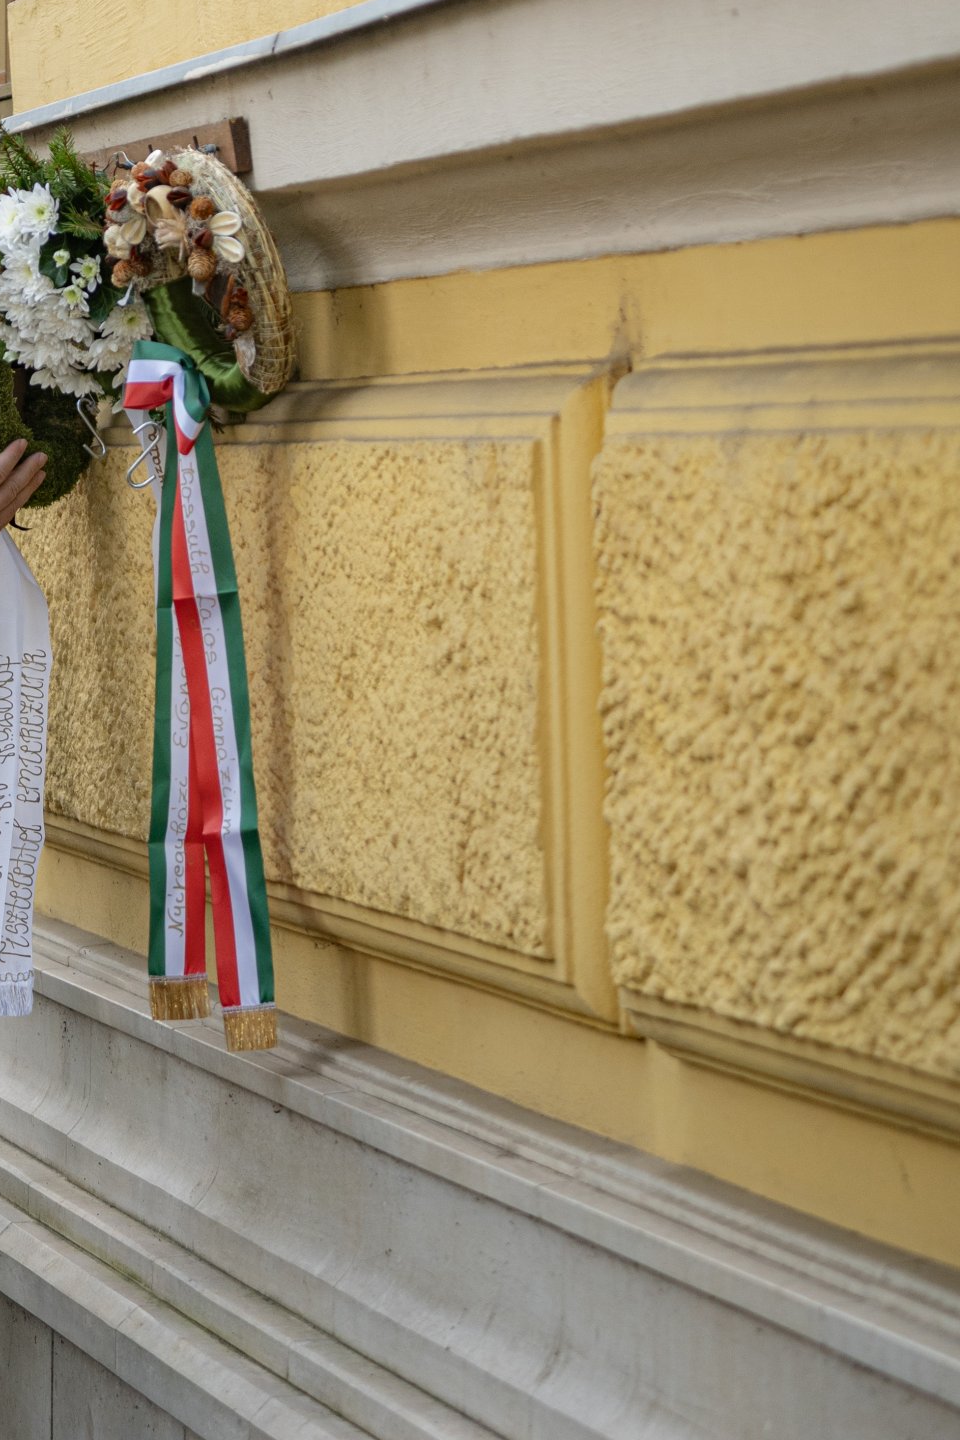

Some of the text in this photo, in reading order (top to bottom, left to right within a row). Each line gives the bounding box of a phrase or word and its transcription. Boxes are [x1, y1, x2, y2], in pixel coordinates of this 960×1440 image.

[180, 461, 236, 840] Kossuth Lajos Gimnázium
